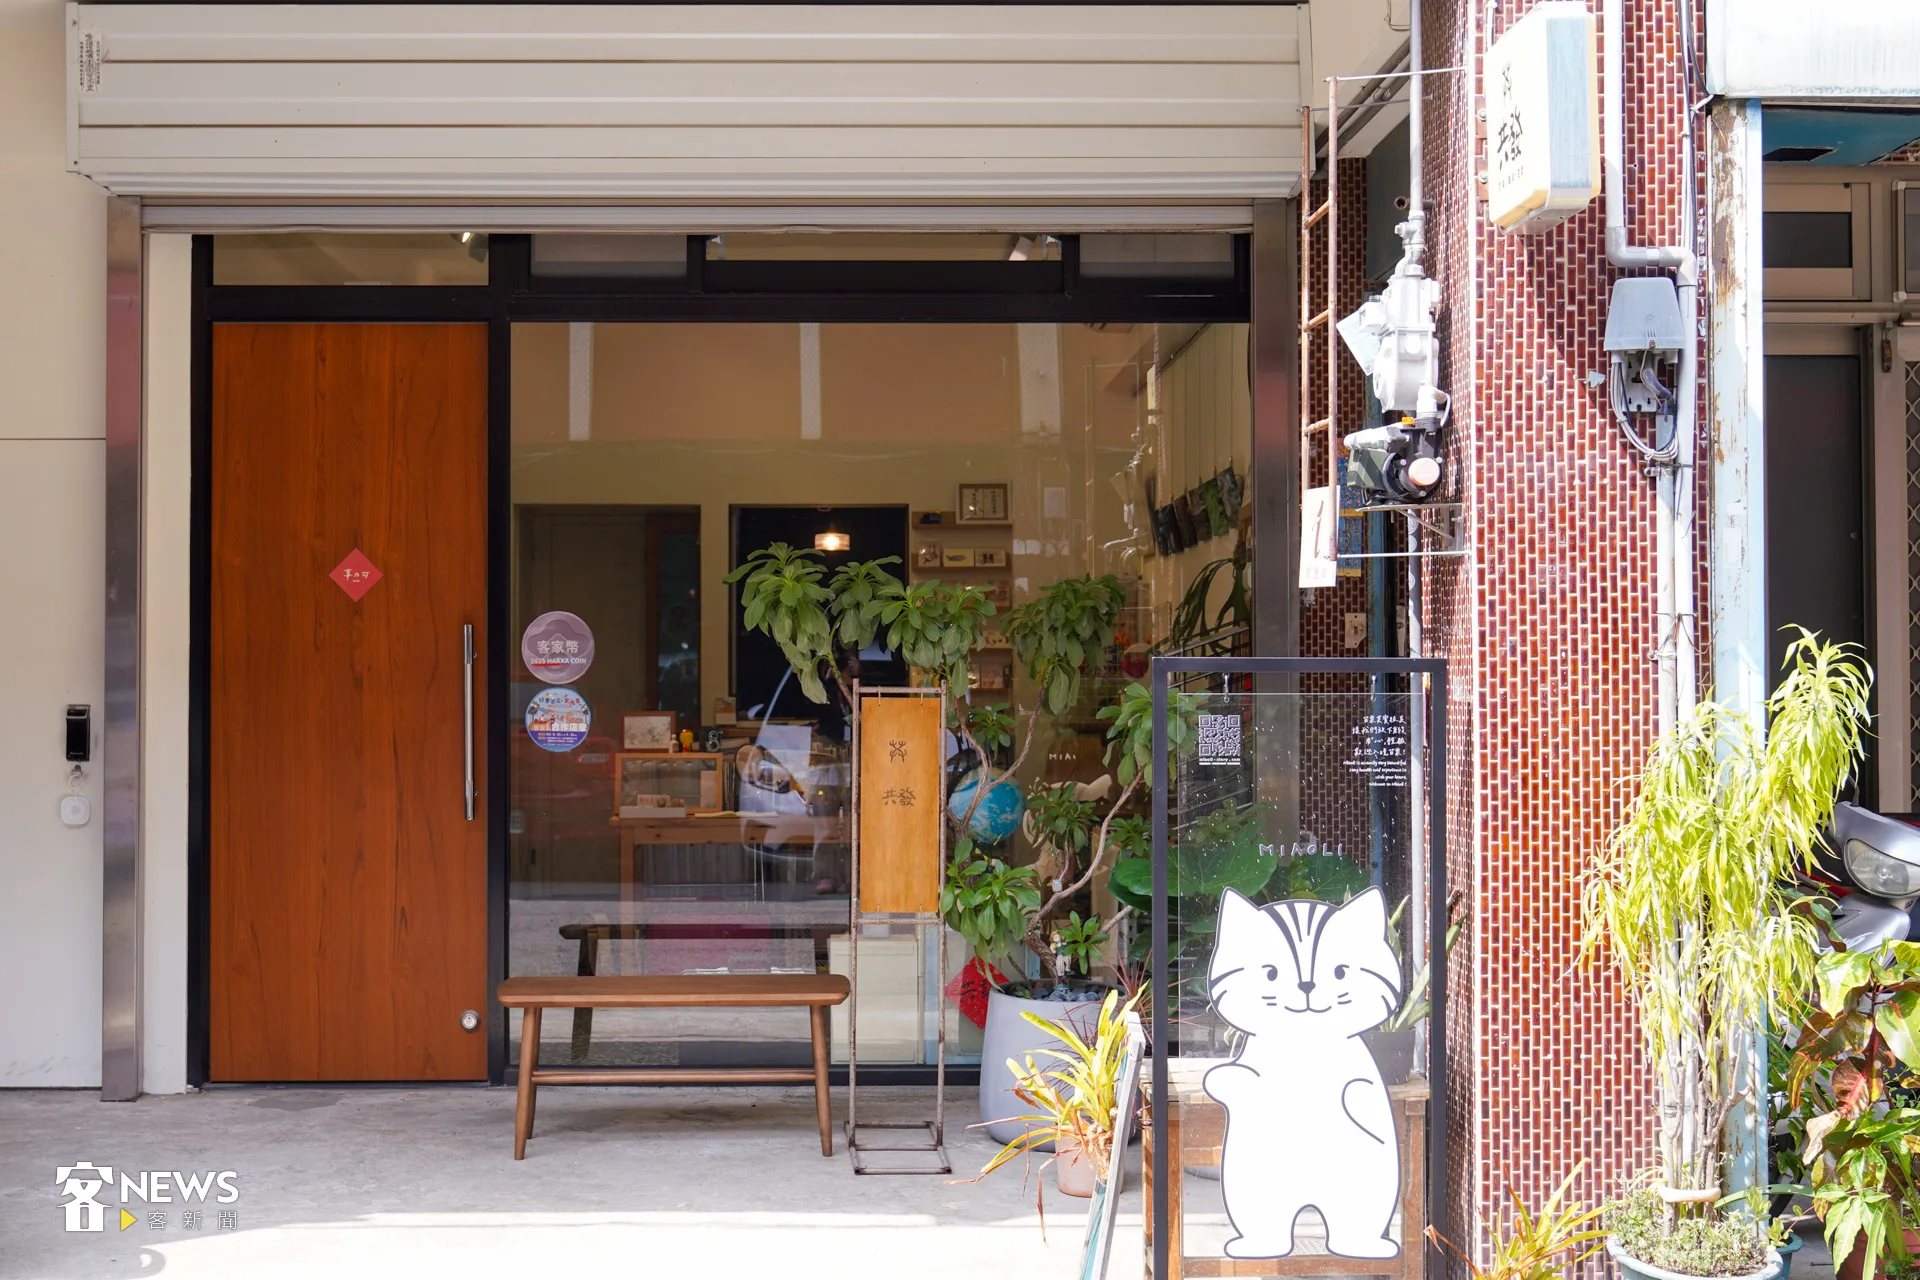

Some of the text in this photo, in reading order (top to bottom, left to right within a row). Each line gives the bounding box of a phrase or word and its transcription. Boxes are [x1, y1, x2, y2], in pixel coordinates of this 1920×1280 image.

[537, 640, 579, 654] 客家幣
[881, 787, 916, 806] 共發
[1259, 842, 1343, 857] MIAOLI
